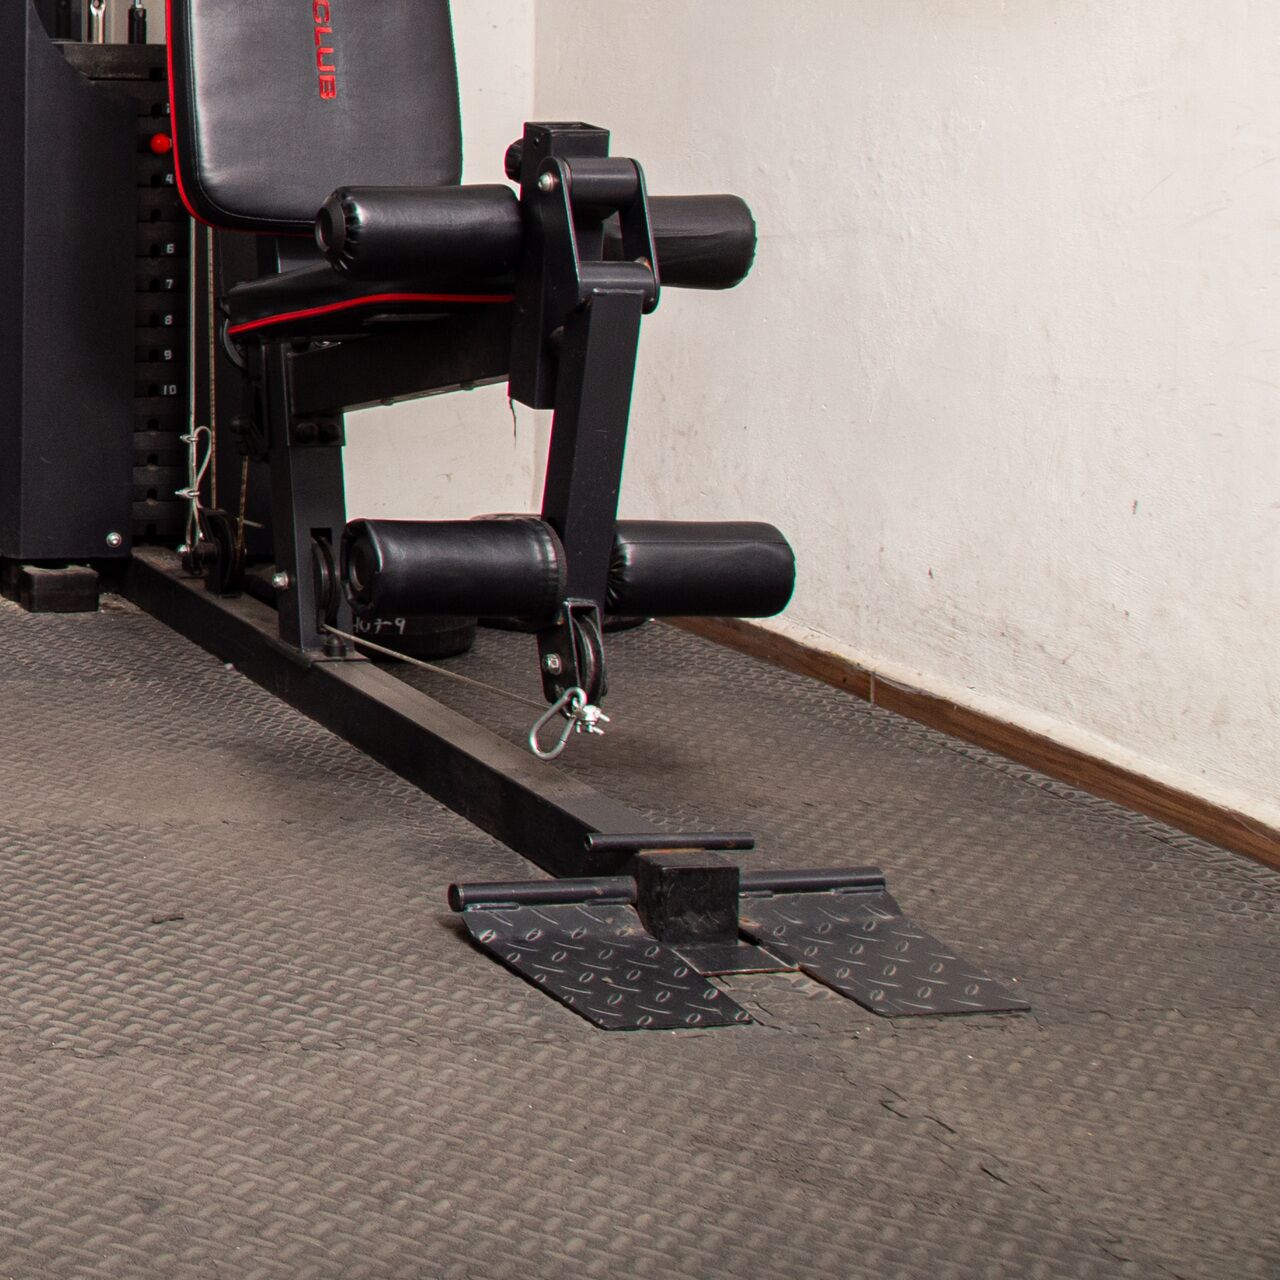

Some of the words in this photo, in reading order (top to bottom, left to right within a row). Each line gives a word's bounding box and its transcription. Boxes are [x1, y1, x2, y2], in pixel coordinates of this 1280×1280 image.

[312, 0, 338, 100] CLUB
[165, 173, 174, 185] 4
[166, 243, 175, 255] 6
[165, 279, 173, 290] 7
[164, 315, 173, 325] 8
[164, 350, 172, 361] 9
[163, 385, 177, 396] 10
